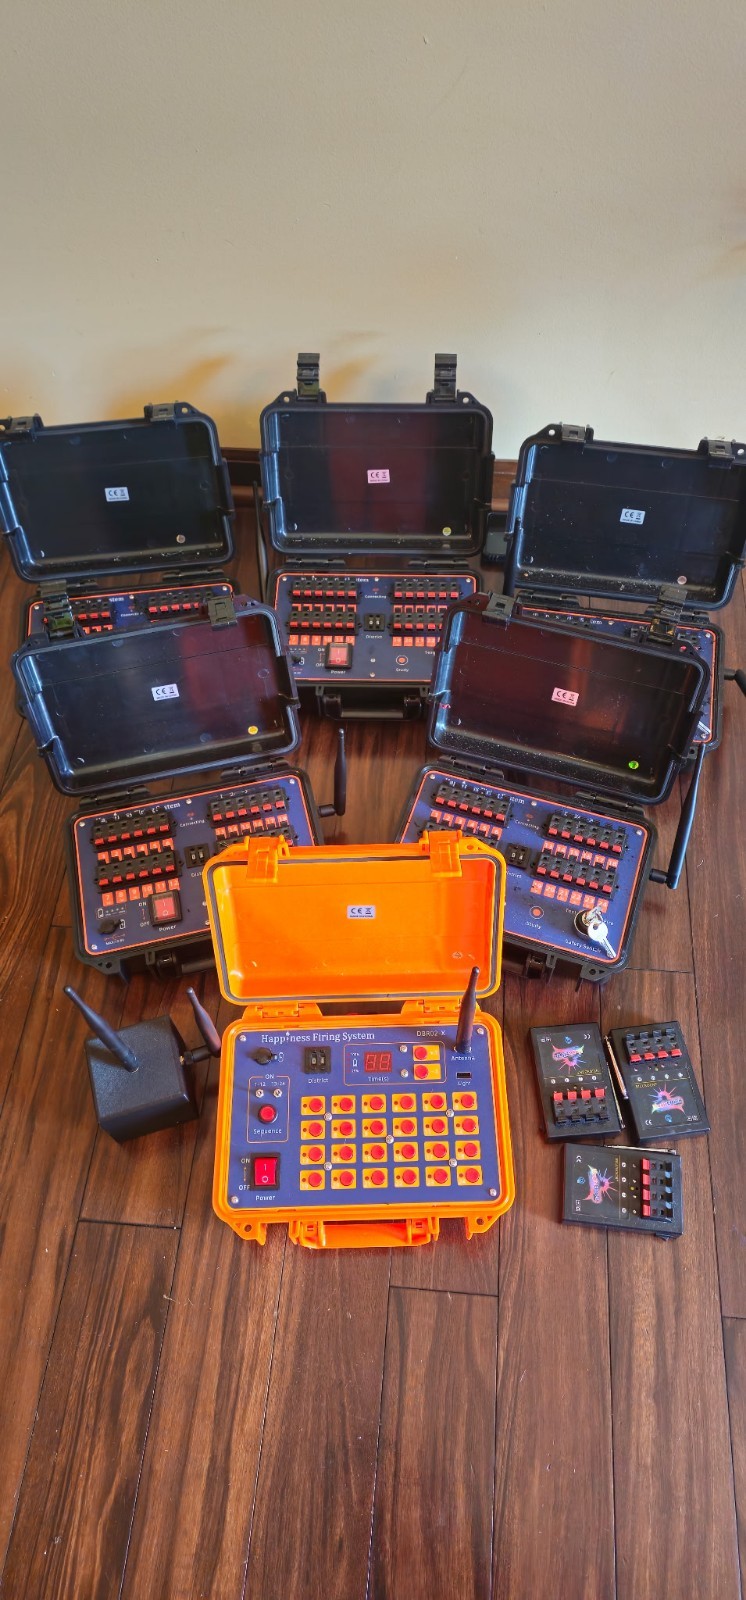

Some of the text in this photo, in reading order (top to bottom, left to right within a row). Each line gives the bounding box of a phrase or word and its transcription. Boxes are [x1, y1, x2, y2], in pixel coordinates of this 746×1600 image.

[261, 1031, 375, 1045] Happiness Firing System
[255, 1194, 276, 1202] Power
